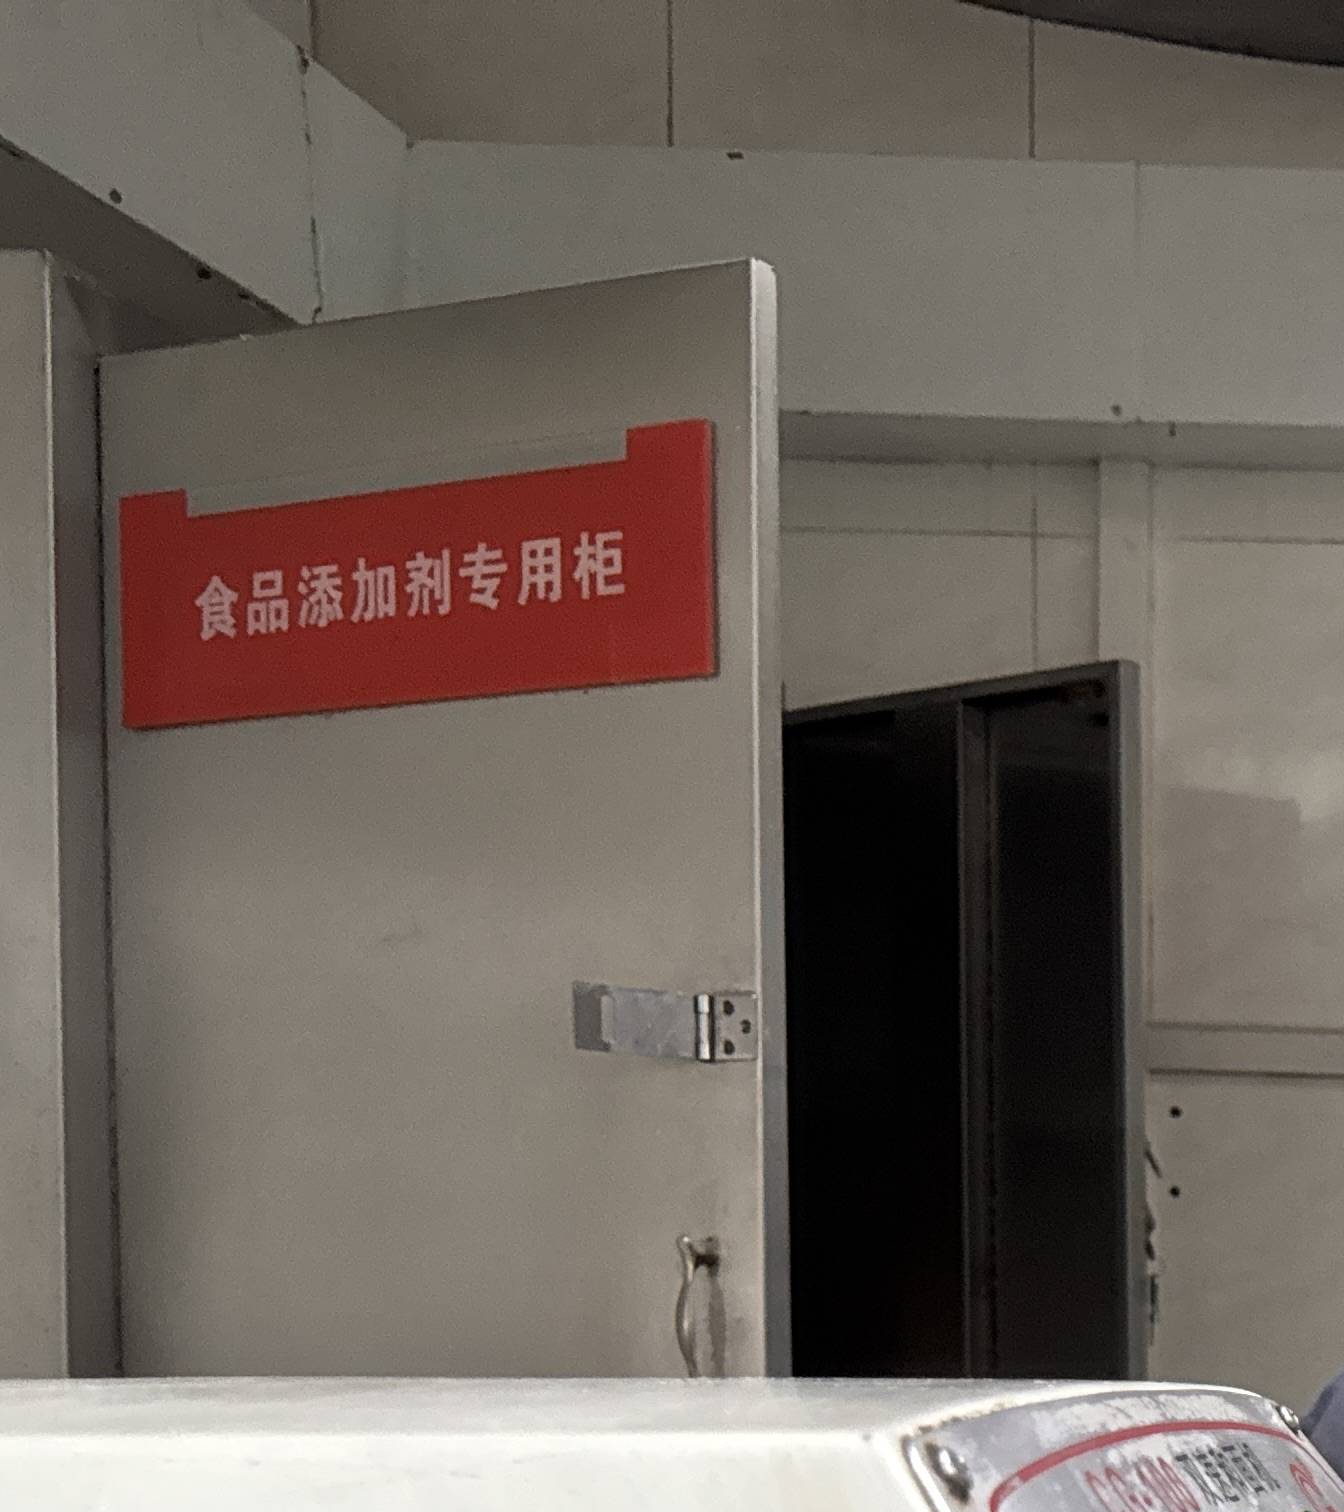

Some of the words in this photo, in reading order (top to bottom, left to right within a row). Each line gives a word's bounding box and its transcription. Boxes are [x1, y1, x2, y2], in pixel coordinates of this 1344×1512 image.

[195, 530, 626, 641] 食品添加剂专用柜
